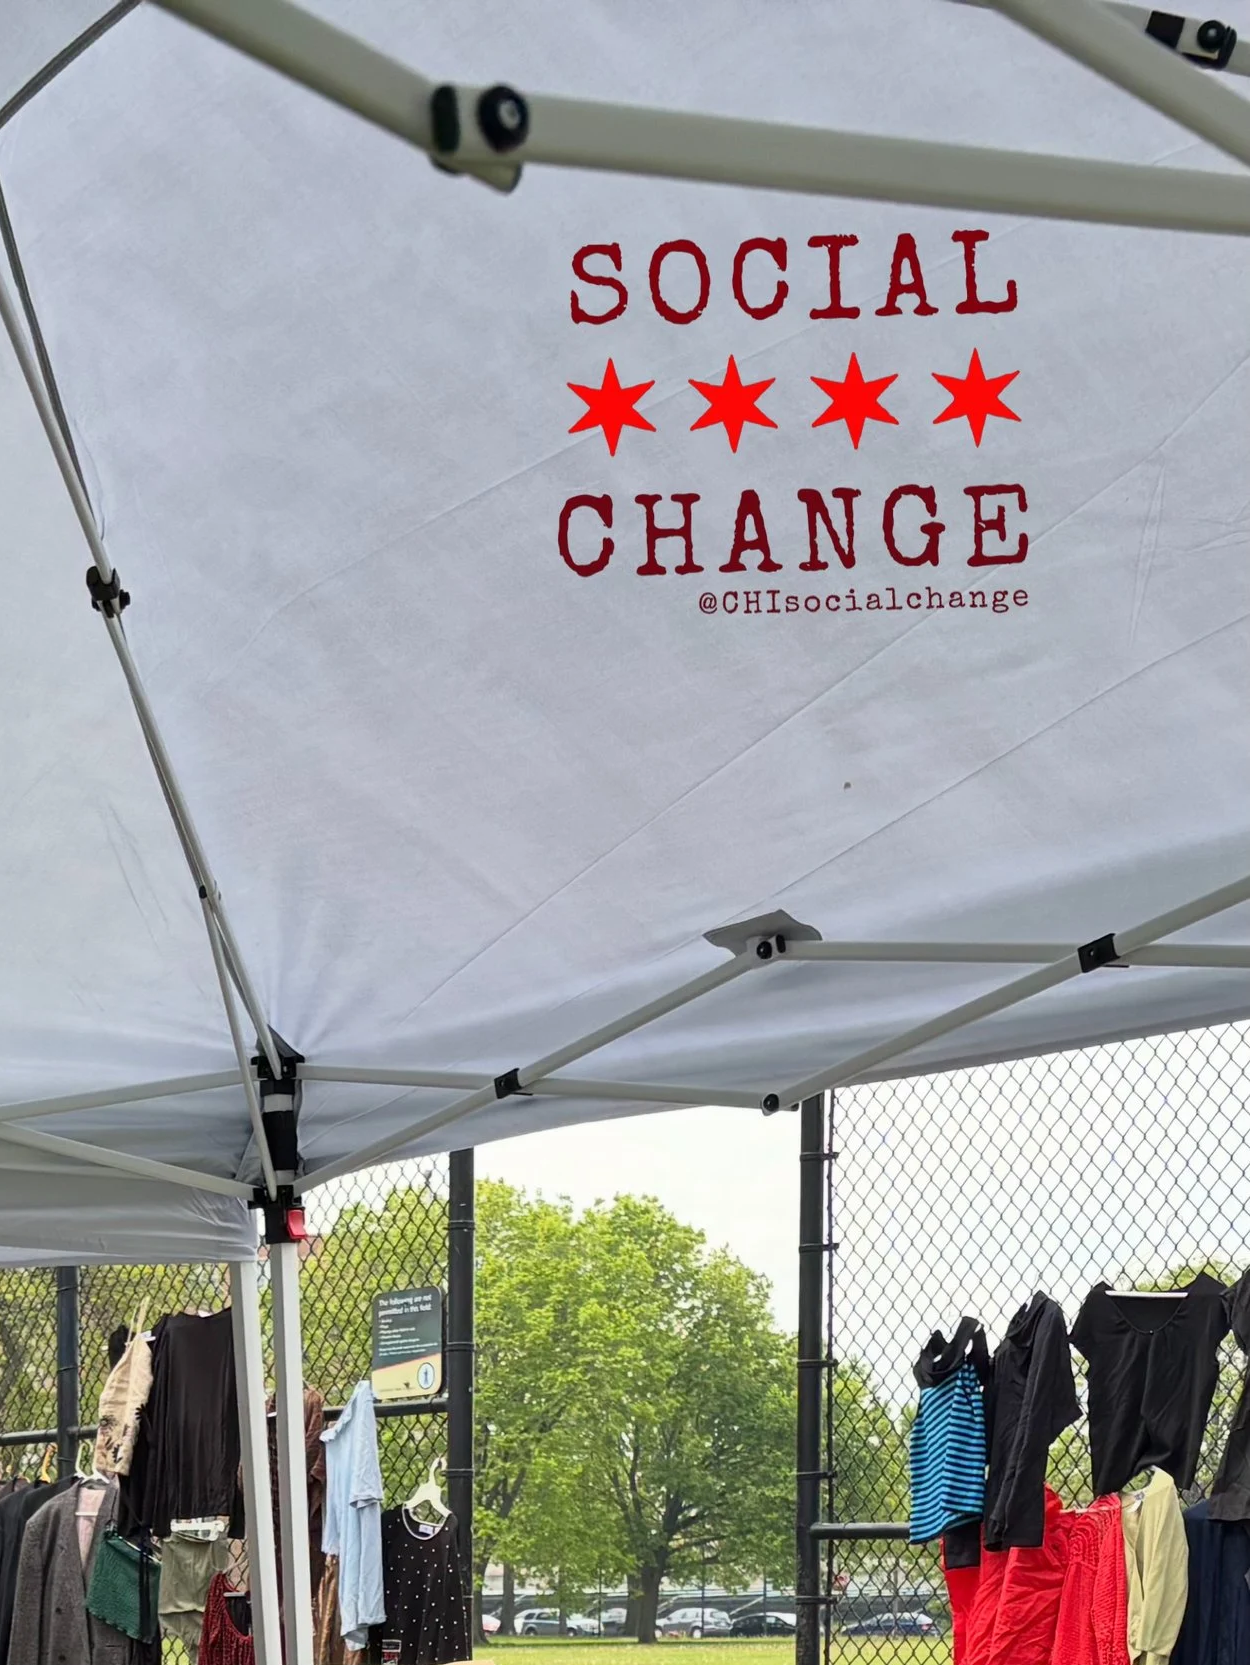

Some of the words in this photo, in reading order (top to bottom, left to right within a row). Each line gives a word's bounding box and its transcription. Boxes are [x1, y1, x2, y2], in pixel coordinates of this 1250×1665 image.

[569, 229, 1018, 326] SOCIAL
[557, 483, 1029, 578] CHANGE
[698, 585, 1029, 616] @CHIsocialchange
